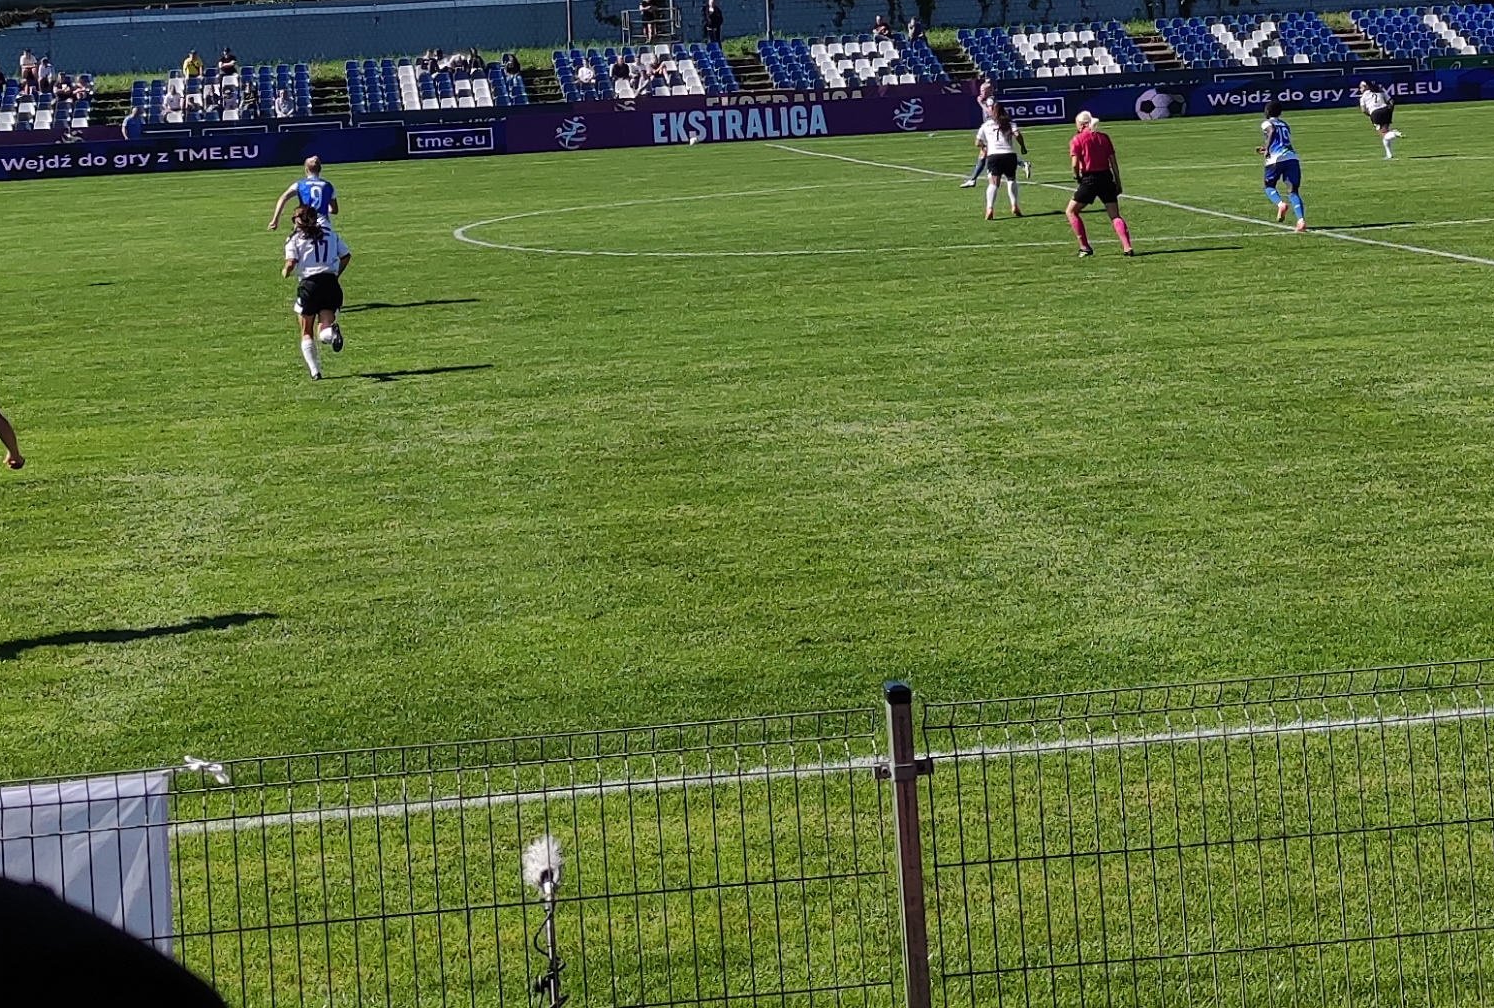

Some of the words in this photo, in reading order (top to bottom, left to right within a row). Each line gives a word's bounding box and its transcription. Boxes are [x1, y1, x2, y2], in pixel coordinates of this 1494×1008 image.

[1207, 90, 1271, 107] Wejdź
[1278, 89, 1304, 102] do
[1309, 88, 1344, 103] gry
[1349, 88, 1362, 98] z
[1375, 81, 1443, 96] ME.EU
[652, 104, 828, 143] EKSTRALIGA
[416, 135, 485, 148] tme.eu
[0, 154, 72, 173] Wejdź
[78, 153, 107, 167] do
[113, 153, 151, 168] gry
[157, 152, 169, 163] z
[174, 145, 259, 162] TME.EU
[310, 185, 323, 211] 9
